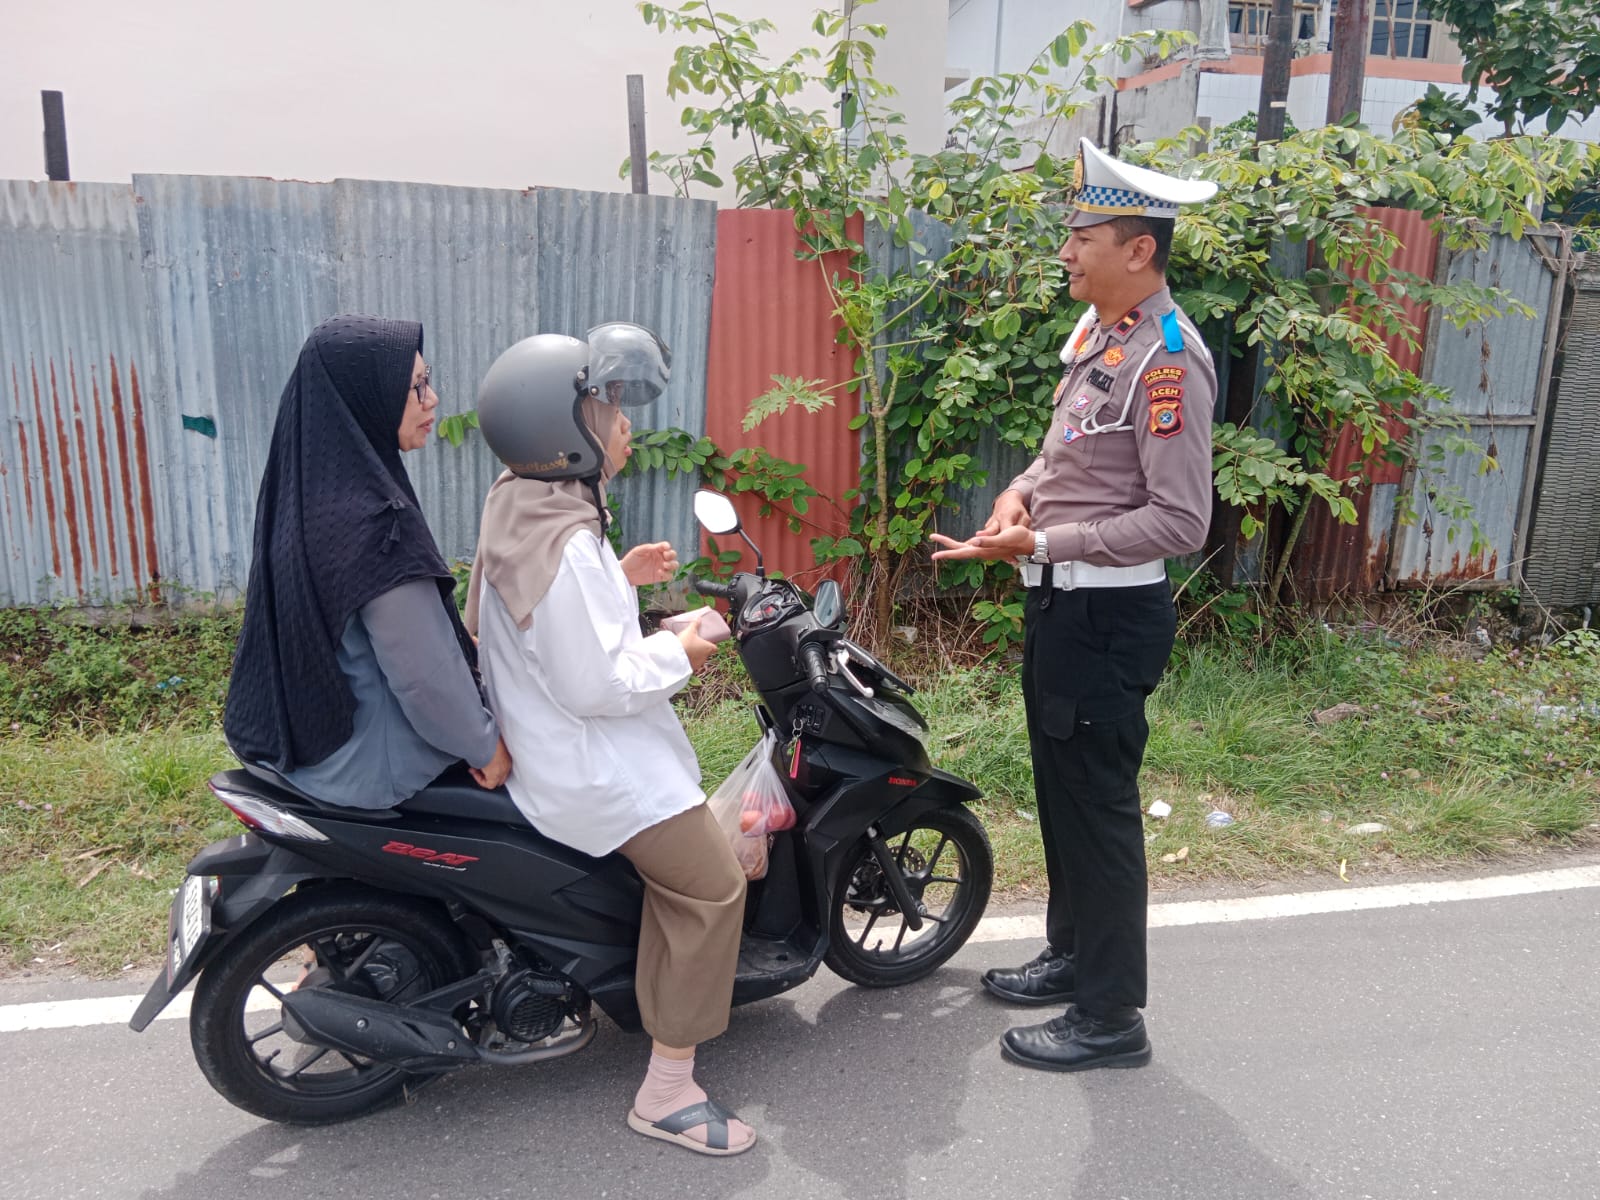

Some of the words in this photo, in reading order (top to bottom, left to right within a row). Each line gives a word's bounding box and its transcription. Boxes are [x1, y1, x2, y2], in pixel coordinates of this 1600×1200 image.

[1144, 368, 1182, 380] POLRES
[1151, 388, 1179, 398] ACEH
[888, 777, 917, 787] HONDA
